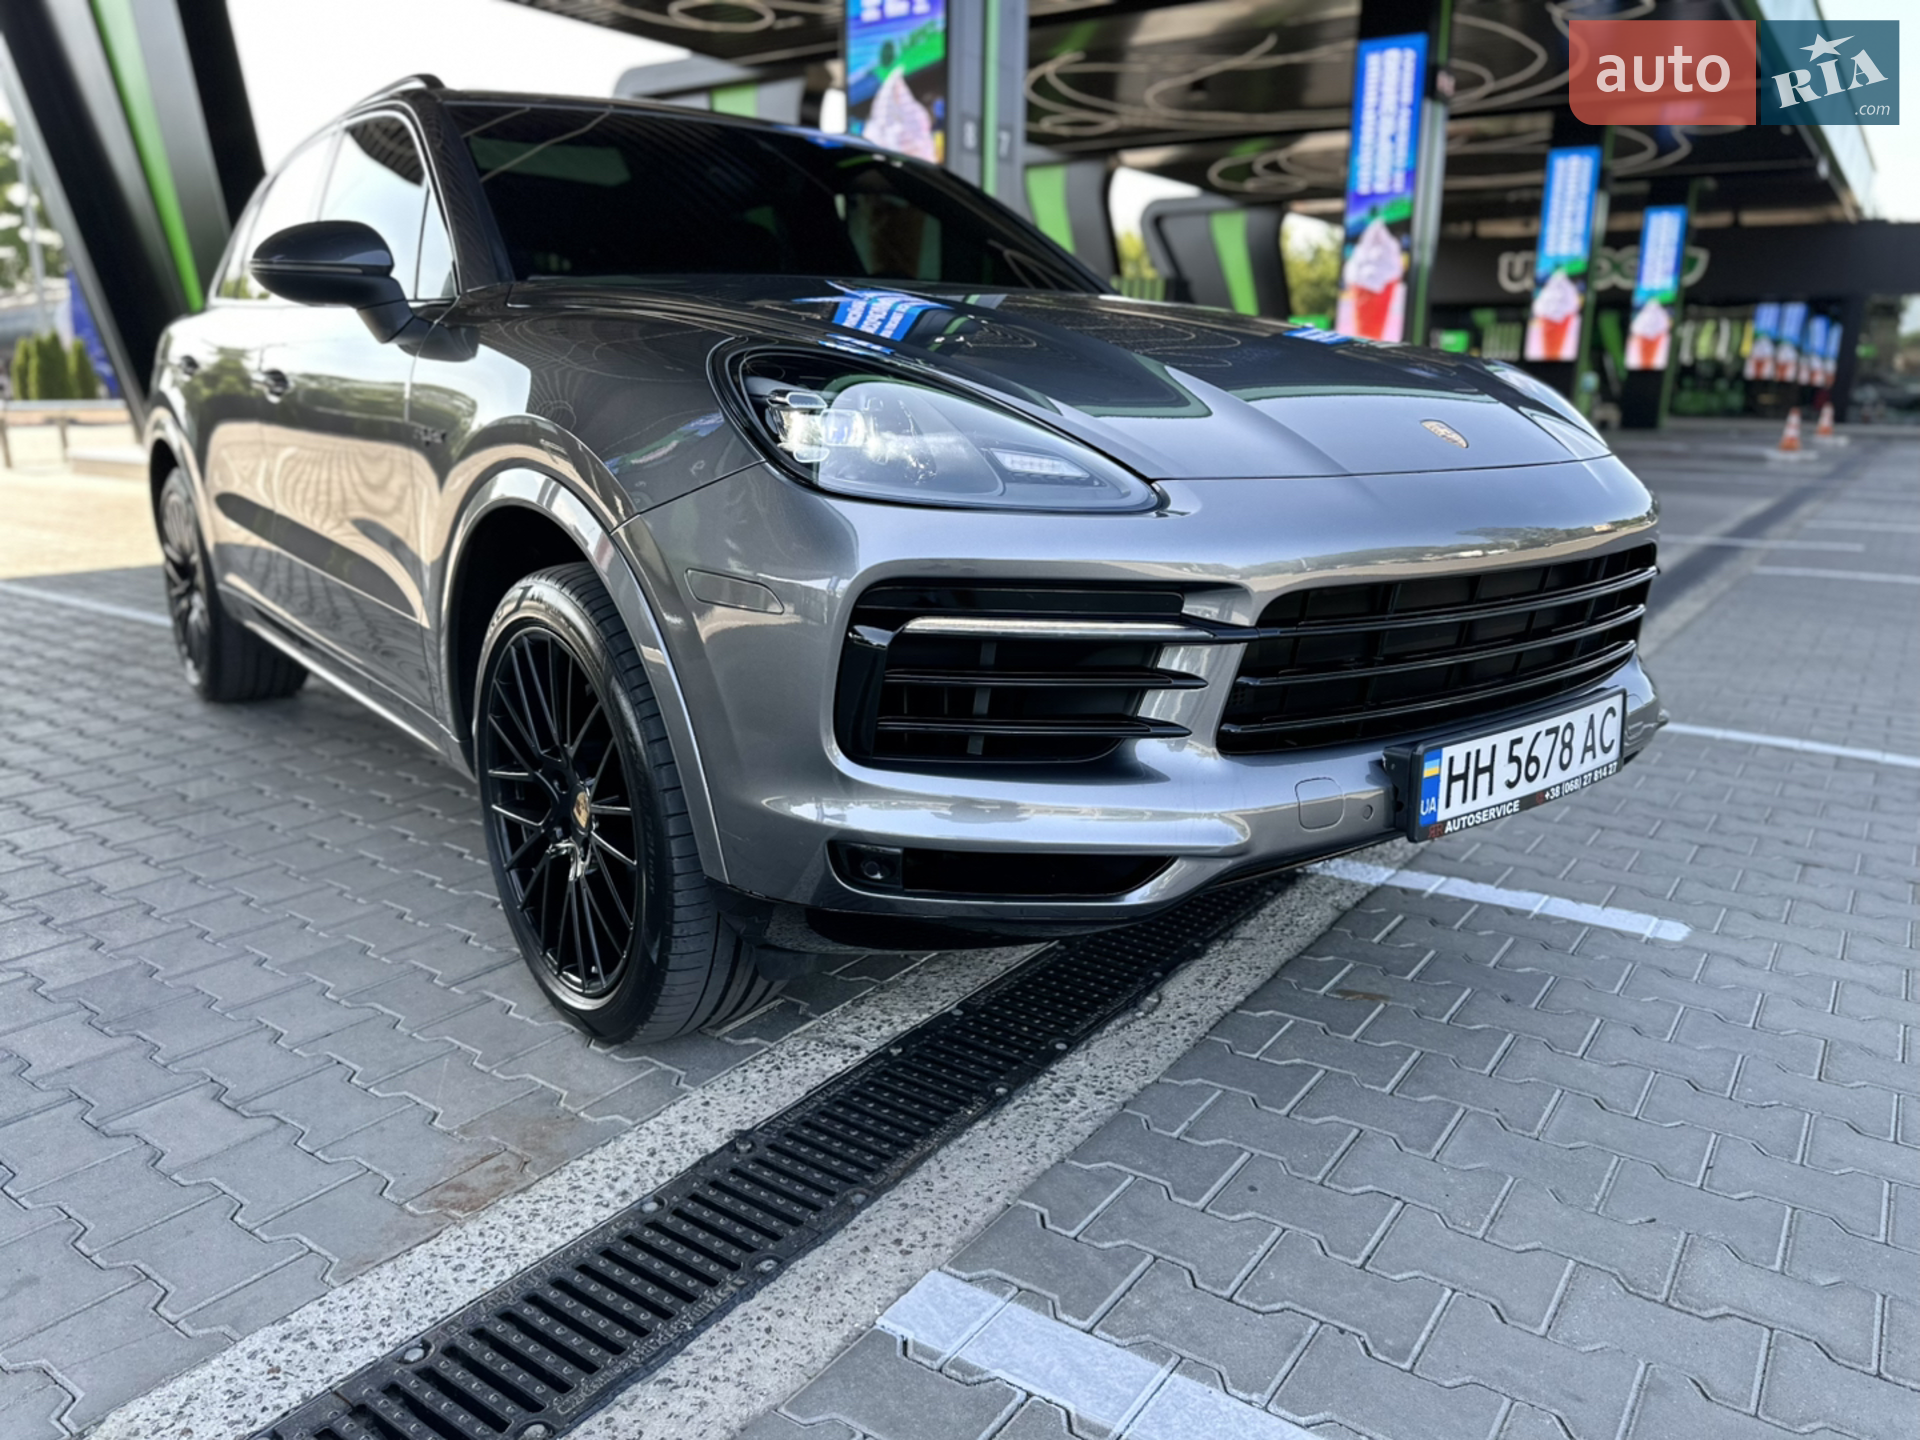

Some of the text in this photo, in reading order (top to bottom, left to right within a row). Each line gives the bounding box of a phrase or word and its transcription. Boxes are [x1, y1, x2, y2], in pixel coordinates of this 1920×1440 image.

[1445, 706, 1617, 809] HH 5678 AC
[1545, 785, 1561, 800] +38
[1420, 797, 1437, 816] UA
[1444, 800, 1520, 834] AUTOSERVICE
